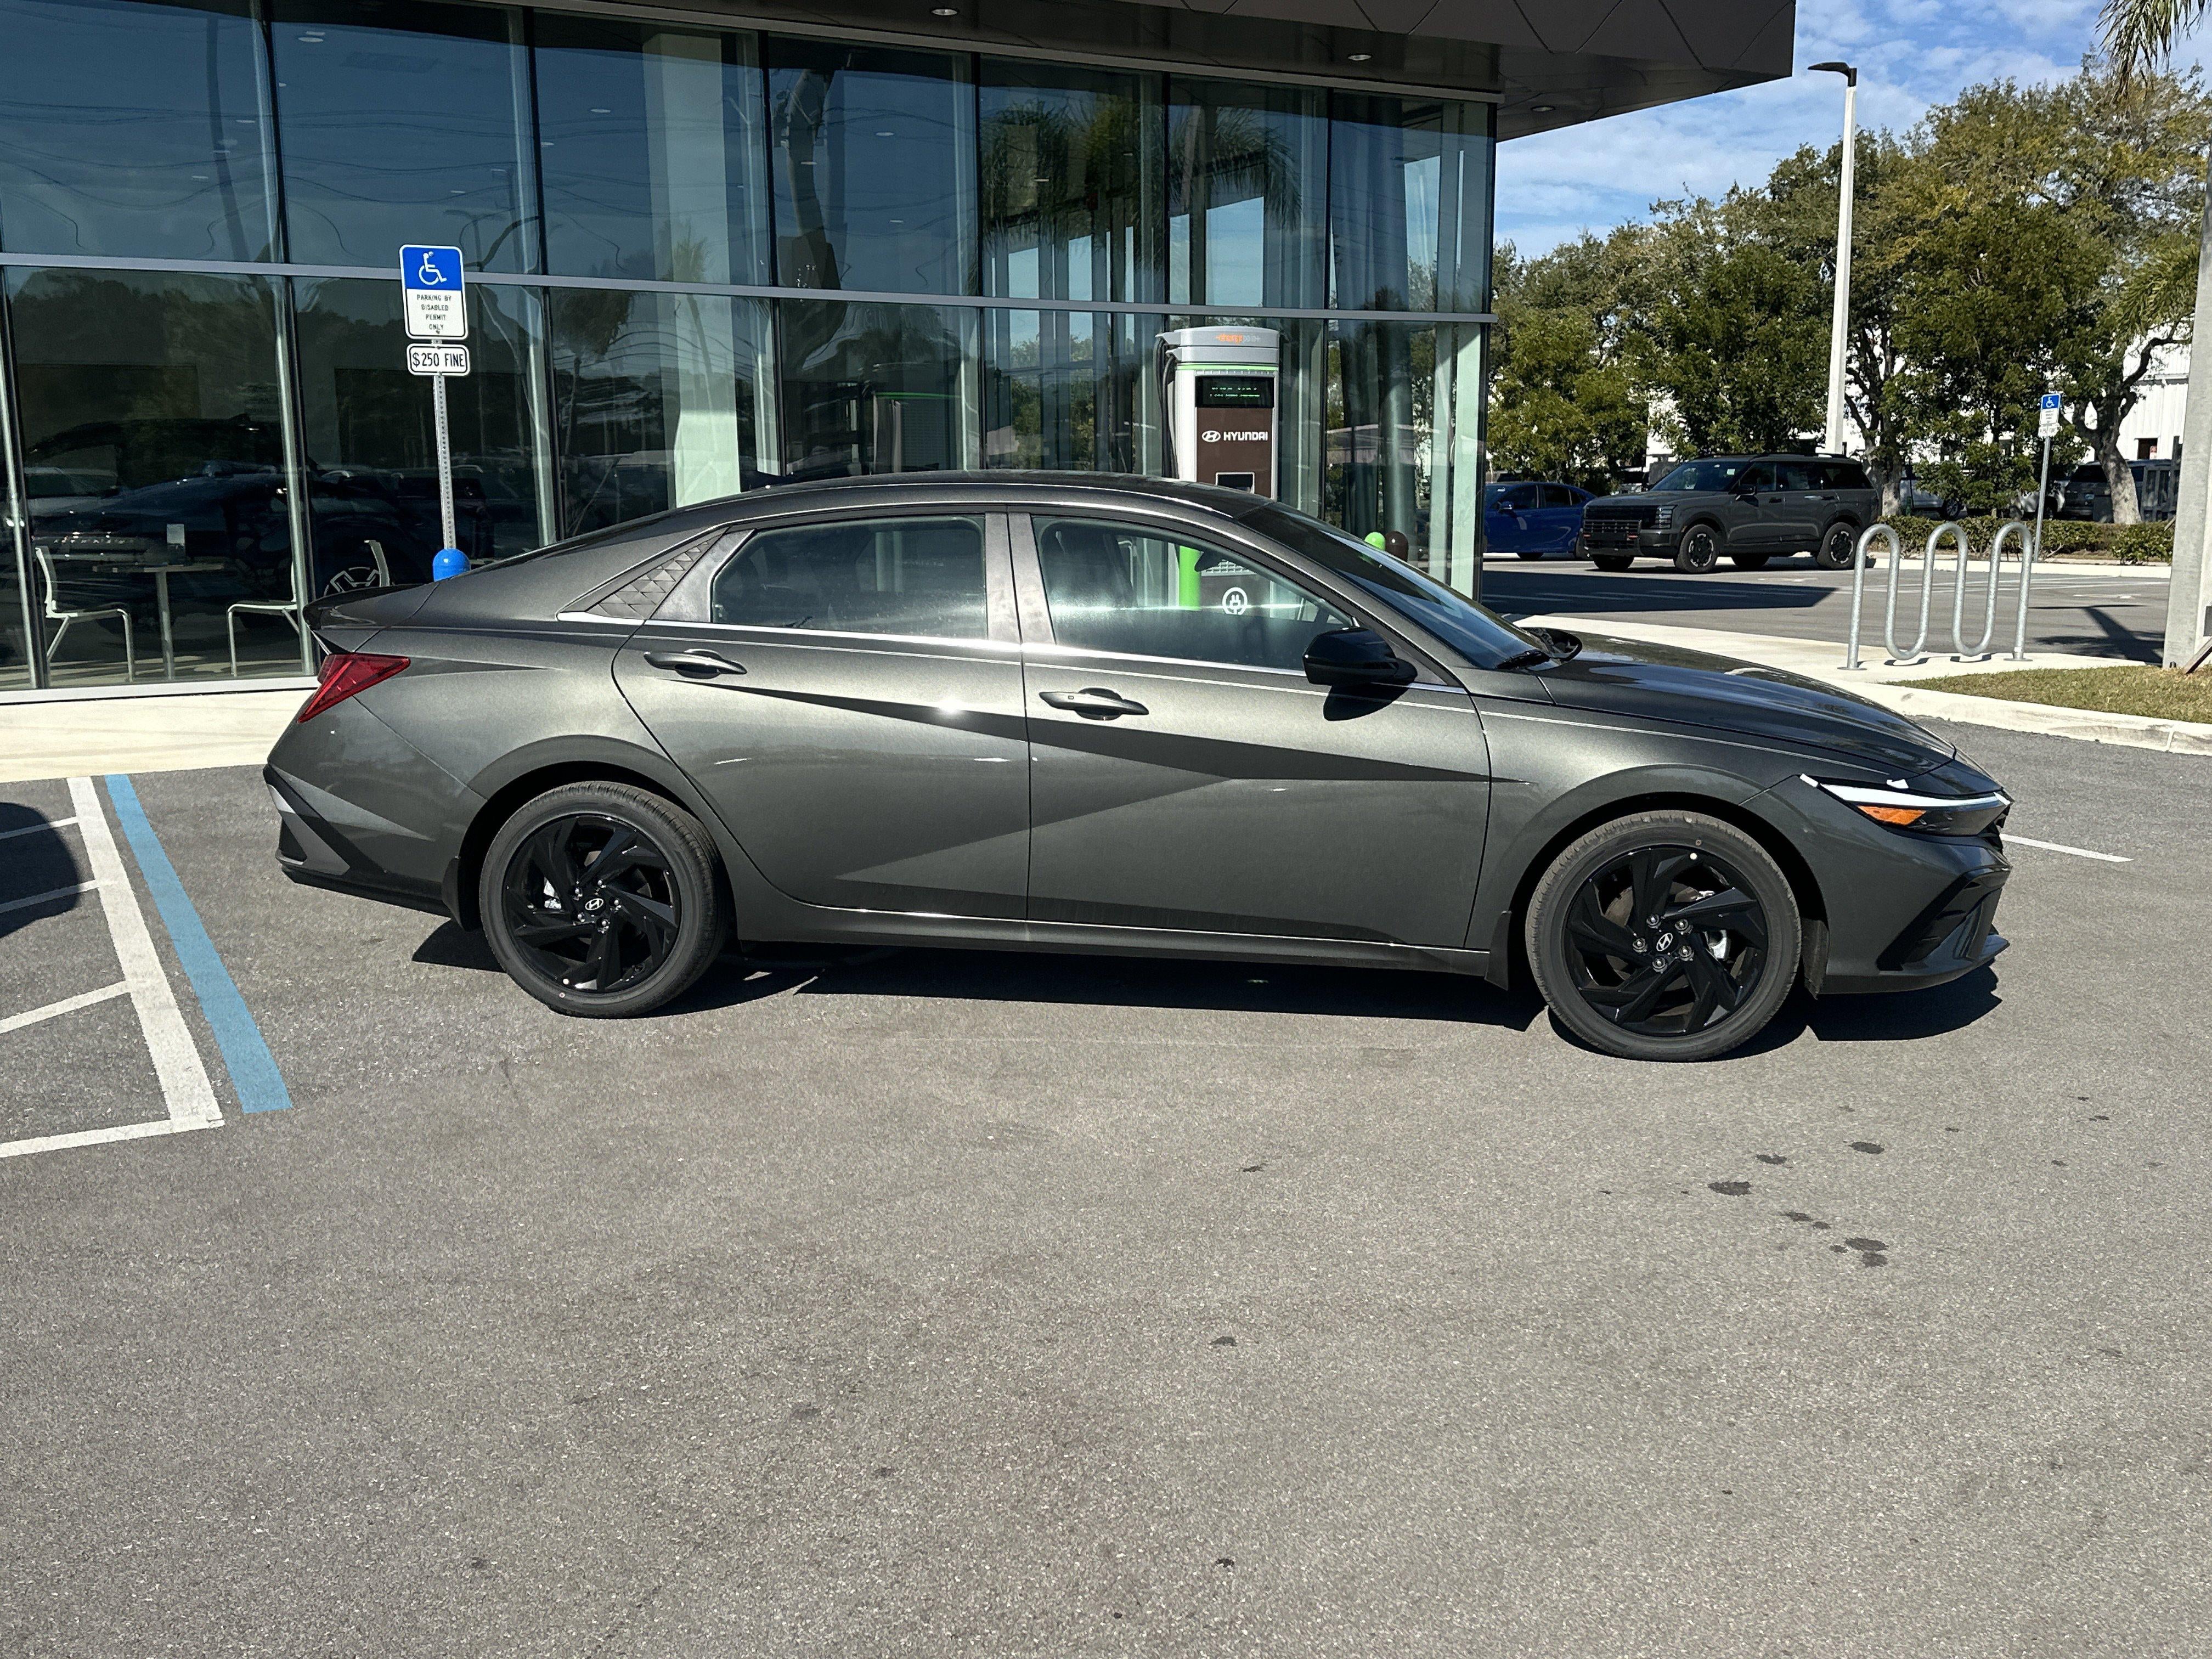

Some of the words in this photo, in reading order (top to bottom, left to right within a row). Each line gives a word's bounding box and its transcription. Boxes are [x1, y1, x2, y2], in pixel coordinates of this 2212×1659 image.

[413, 352, 439, 368] $250
[444, 353, 465, 367] FINE
[1223, 431, 1268, 441] HYUNDAI
